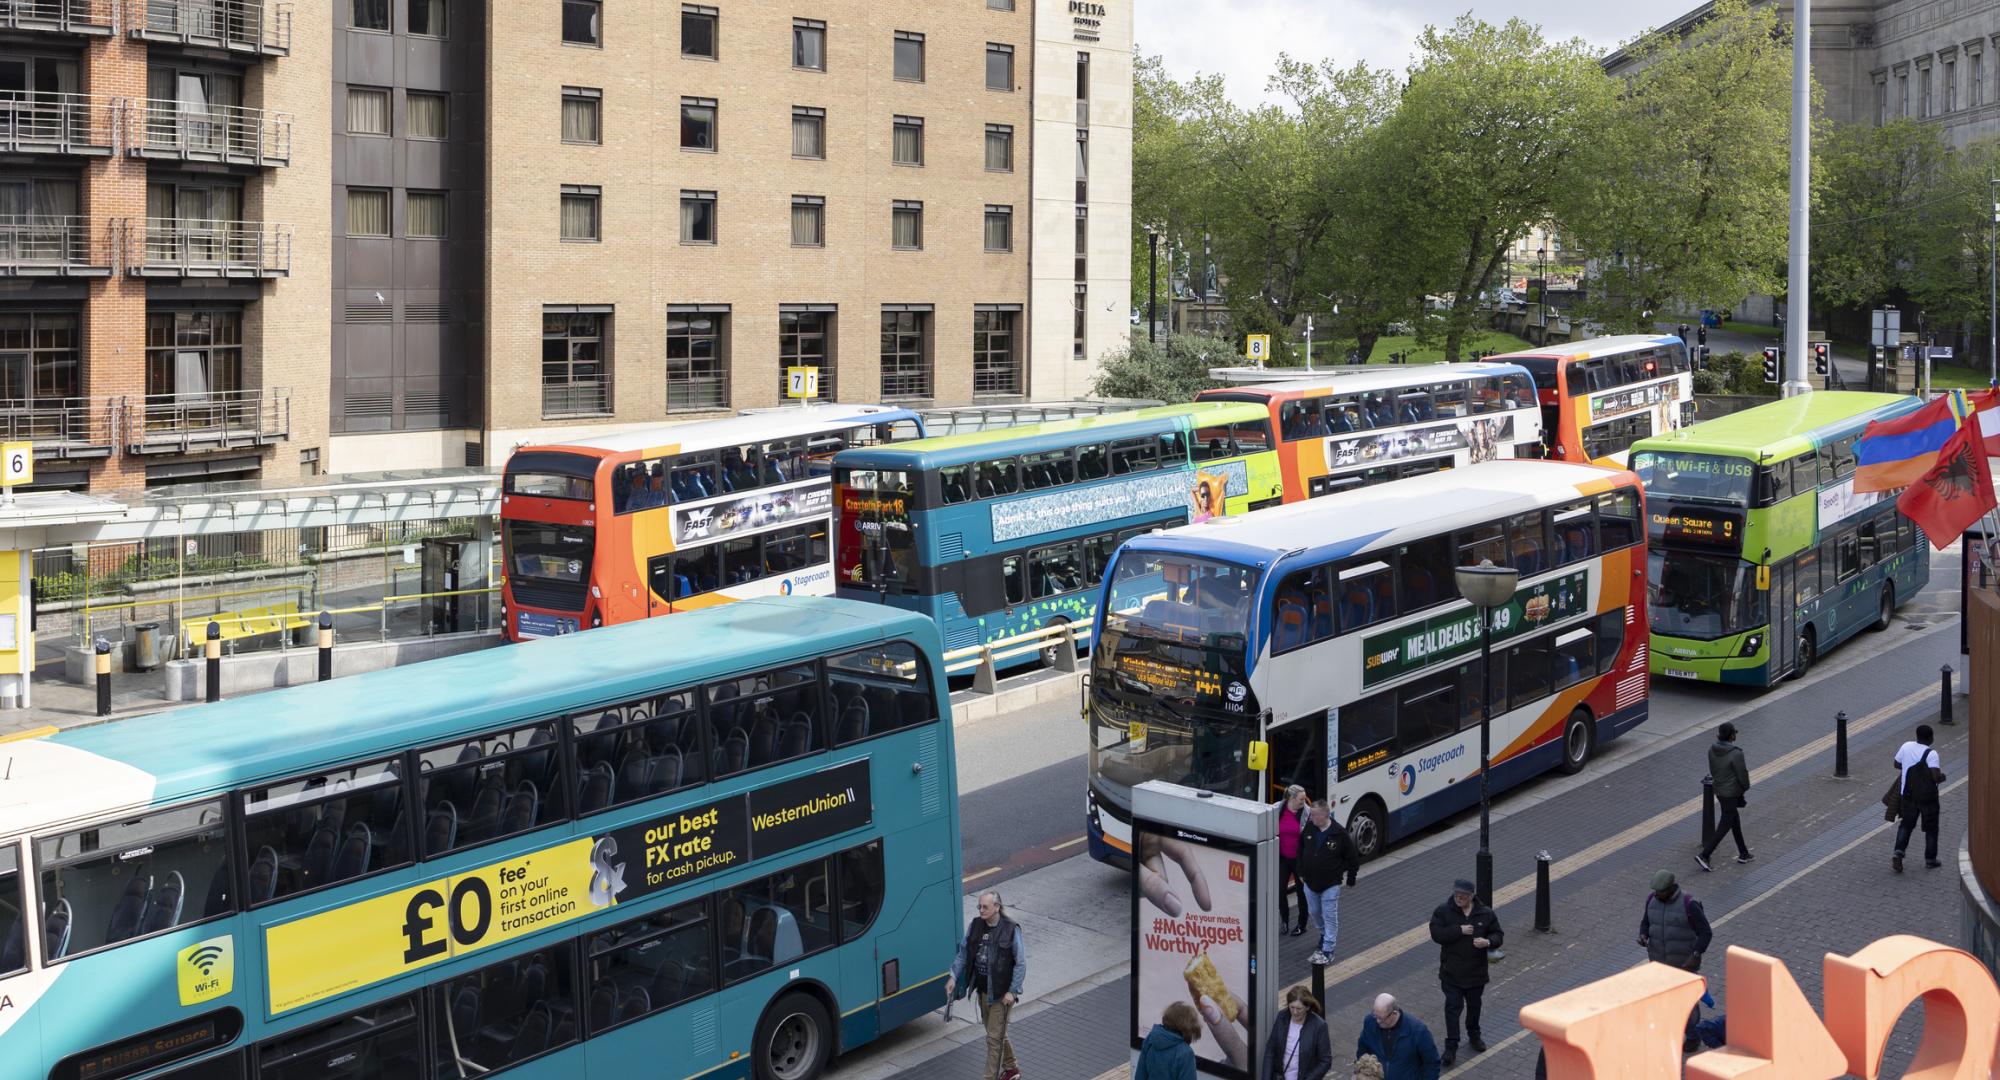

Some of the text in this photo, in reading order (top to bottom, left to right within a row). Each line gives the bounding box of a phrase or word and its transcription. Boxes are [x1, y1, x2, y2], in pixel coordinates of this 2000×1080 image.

[1069, 0, 1106, 16] DELTA
[1253, 342, 1260, 353] 8
[794, 375, 801, 390] 7
[810, 375, 814, 389] 7
[1336, 446, 1360, 460] FAST
[12, 454, 23, 473] 6
[1675, 460, 1710, 473] Wi-Fi
[1711, 461, 1721, 474] &
[1724, 464, 1753, 477] USB
[893, 499, 905, 515] 18
[1071, 501, 1093, 513] thing
[684, 516, 714, 533] FAST
[862, 521, 882, 531] ARRIV
[1653, 514, 1733, 537] Queen Square 9
[794, 569, 830, 586] Stagecoach
[1407, 607, 1511, 661] MEAL DEALS £.49
[1366, 647, 1400, 669] SUBWAY
[1225, 702, 1244, 713] 11104
[1418, 744, 1465, 773] Stagecoach
[752, 789, 848, 832] WesternUnion
[645, 808, 718, 845] our best
[645, 842, 671, 868] FX
[646, 849, 737, 886] for cash pickup.
[500, 876, 549, 900] on your
[501, 887, 569, 916] first online
[402, 876, 492, 965] £0
[501, 901, 576, 932] transaction
[1186, 912, 1241, 925] Are your mates
[1153, 918, 1244, 945] #McNugget
[1145, 933, 1210, 958] Worthy?
[195, 979, 219, 993] Wi-Fi
